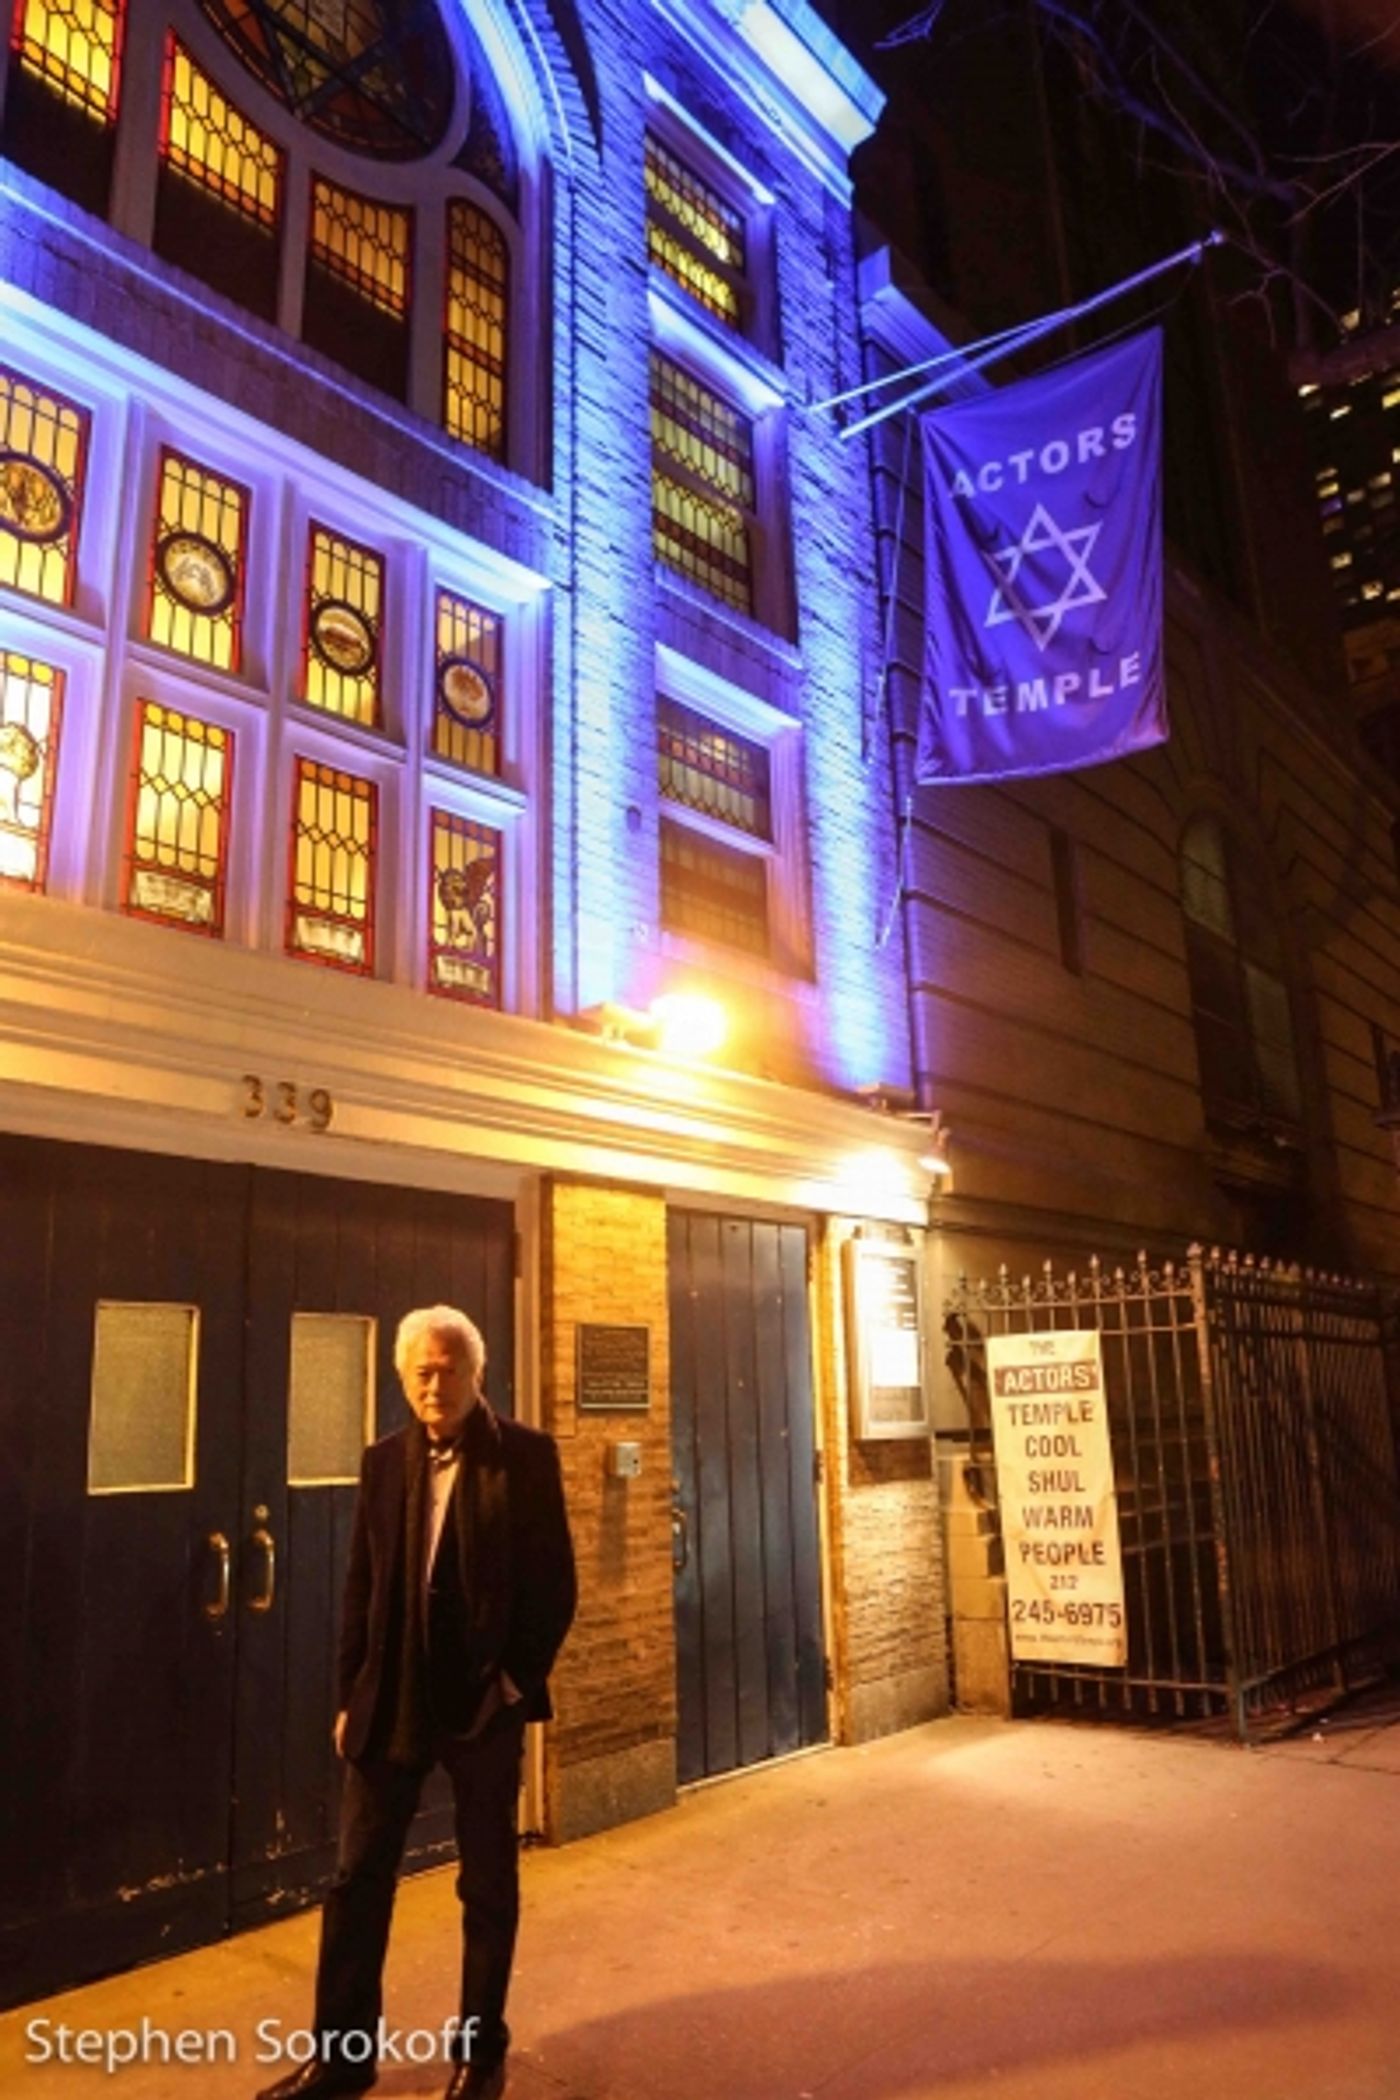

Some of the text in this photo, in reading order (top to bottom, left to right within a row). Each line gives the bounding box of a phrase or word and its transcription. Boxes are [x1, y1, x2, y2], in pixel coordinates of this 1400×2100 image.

[950, 413, 1137, 499] ACTORS
[948, 651, 1141, 718] TEMPLE
[242, 1074, 333, 1132] 339
[1008, 1401, 1093, 1426] TEMPLE
[1026, 1434, 1082, 1457] COOL
[1029, 1470, 1086, 1494] SHUL
[1022, 1505, 1093, 1528] WARM
[1019, 1541, 1105, 1566] PEOPLE
[1050, 1575, 1077, 1590] 212
[1012, 1600, 1121, 1628] 245-6975
